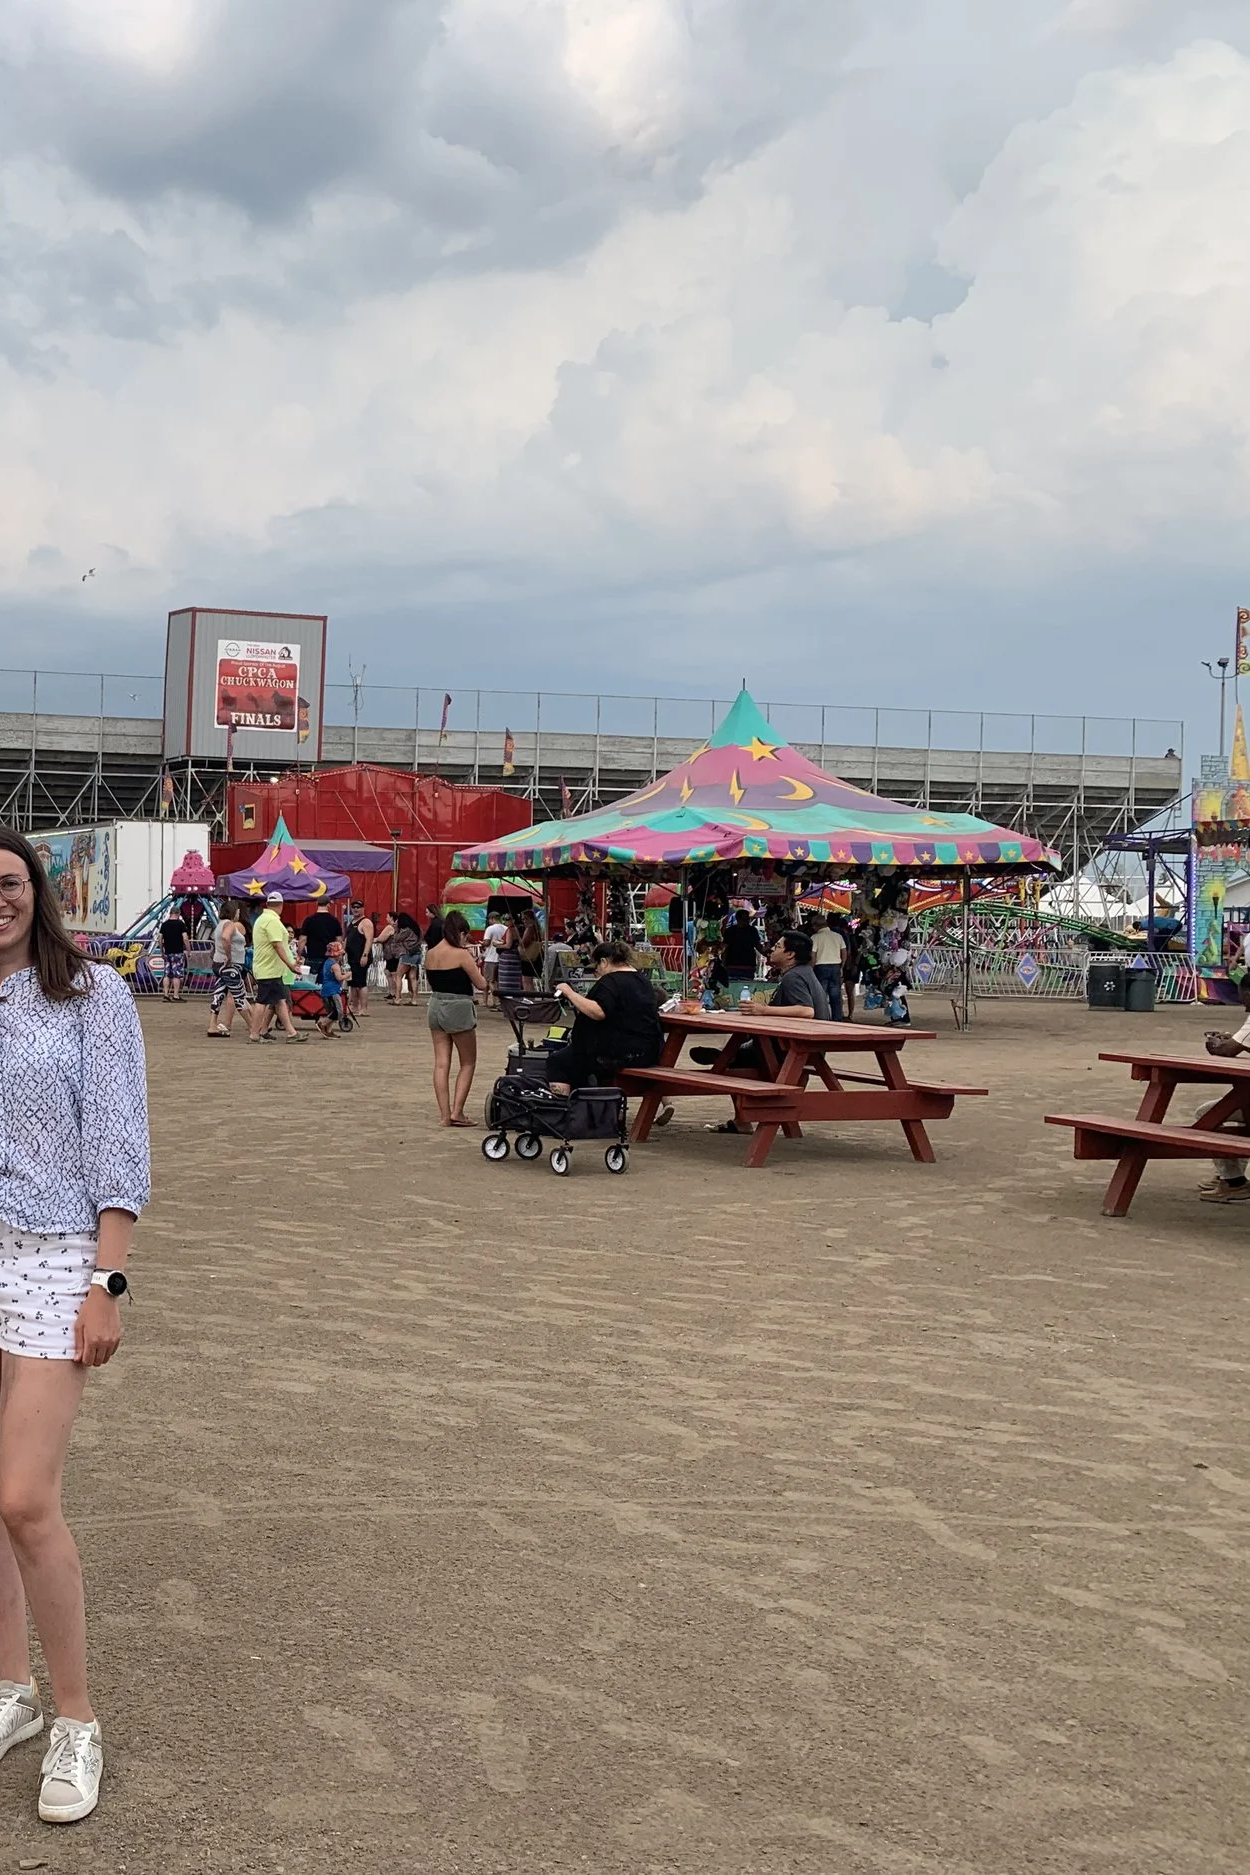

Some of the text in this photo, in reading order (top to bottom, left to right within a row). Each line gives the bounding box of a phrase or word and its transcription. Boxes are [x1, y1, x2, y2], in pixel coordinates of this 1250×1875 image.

[246, 647, 277, 655] NISSAN
[238, 666, 277, 679] CPCA
[220, 676, 295, 689] CHUCKWAGON
[230, 712, 282, 726] FINALS
